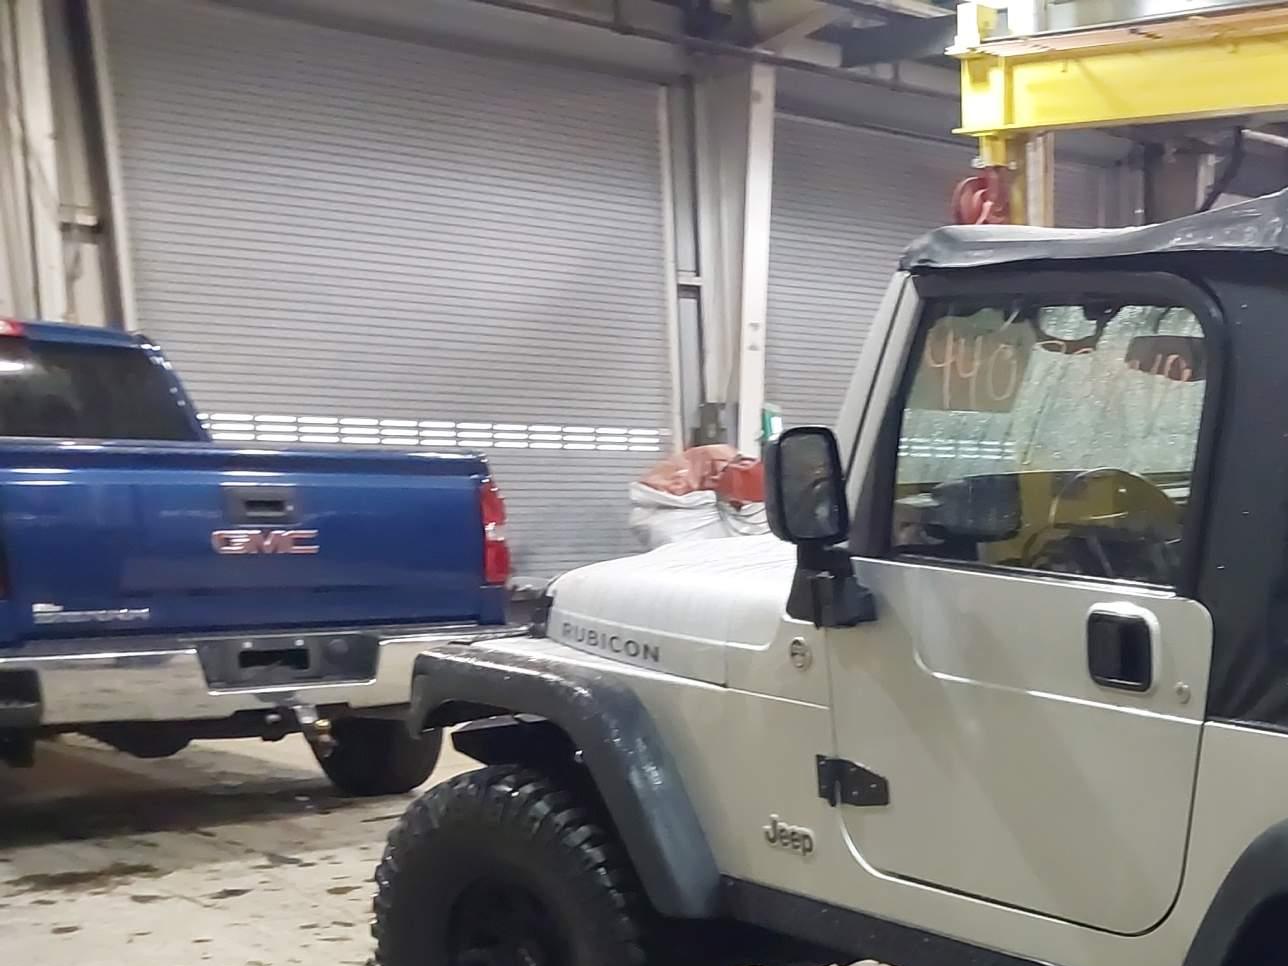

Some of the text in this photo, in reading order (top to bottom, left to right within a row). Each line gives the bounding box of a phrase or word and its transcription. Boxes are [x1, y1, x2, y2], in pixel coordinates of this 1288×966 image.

[211, 529, 320, 555] GMC
[561, 621, 661, 663] RUBICON
[763, 813, 814, 857] Jeep
